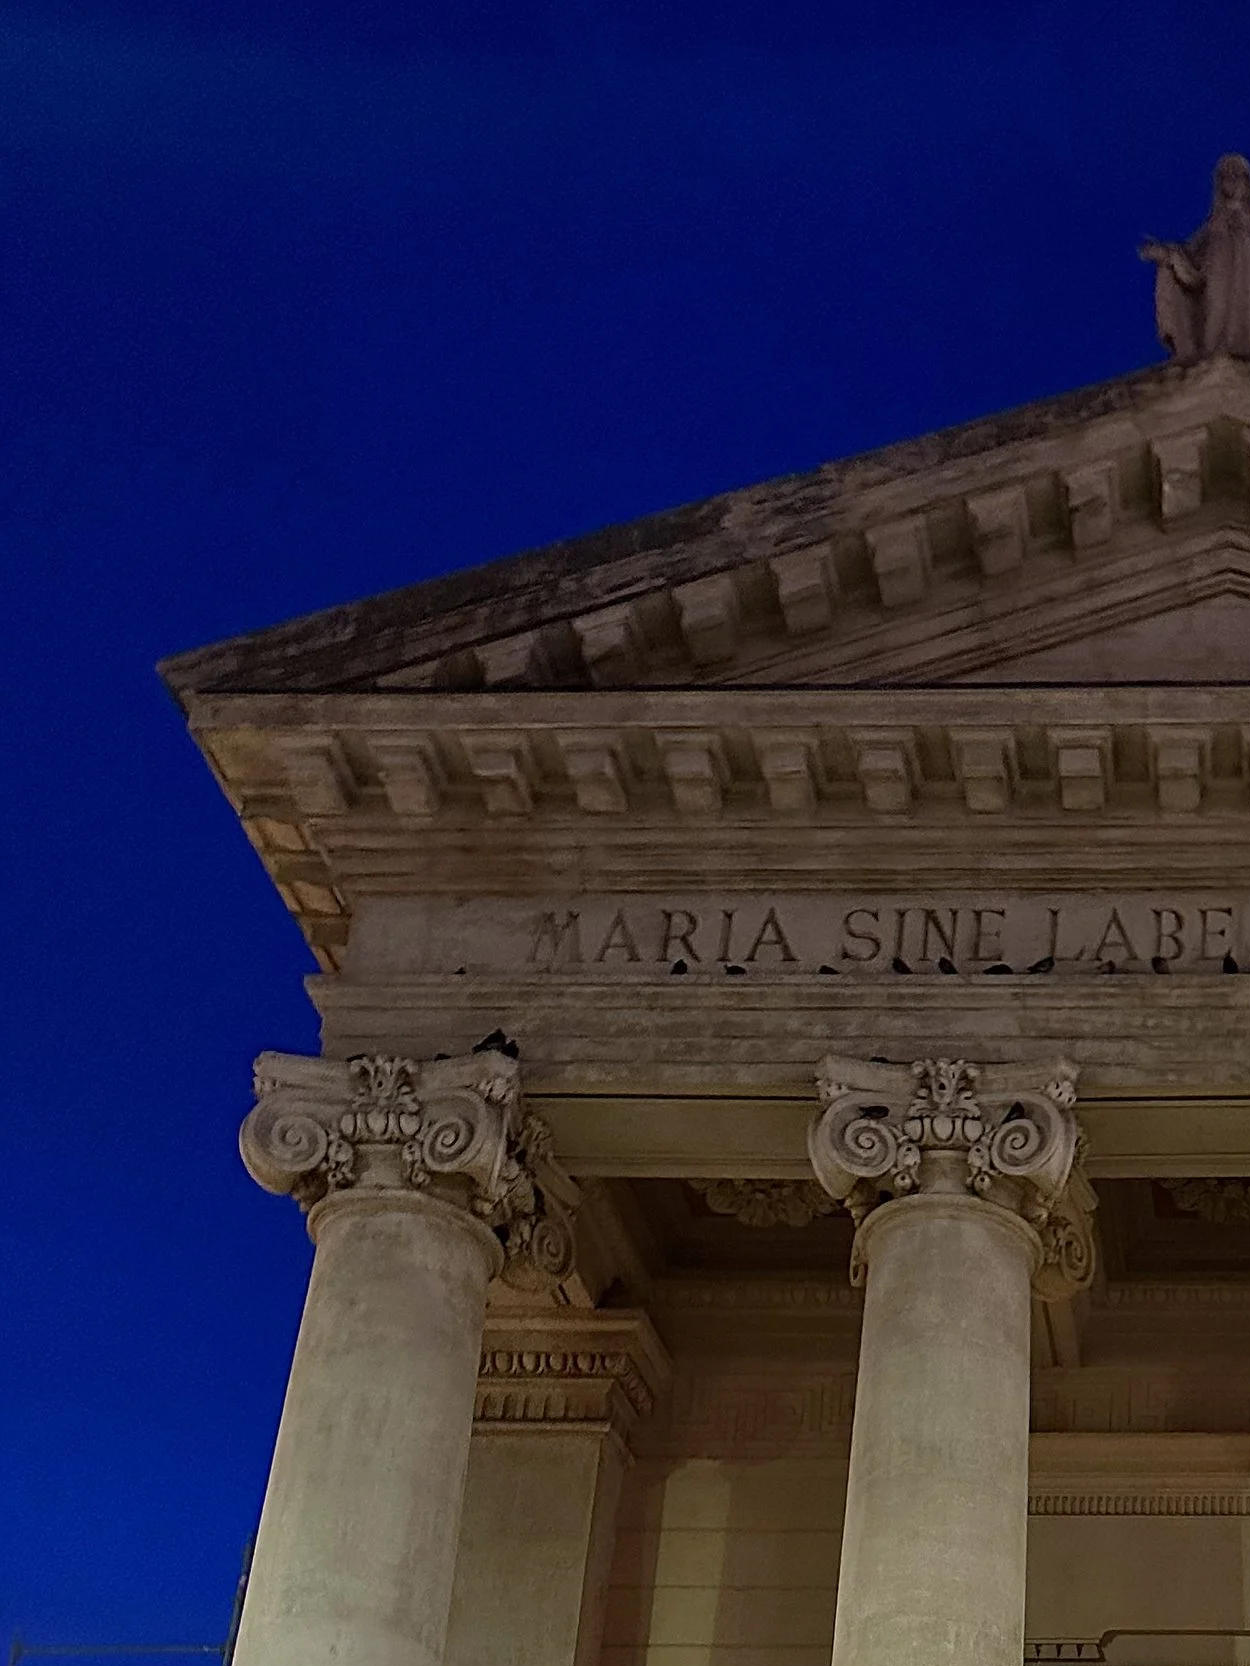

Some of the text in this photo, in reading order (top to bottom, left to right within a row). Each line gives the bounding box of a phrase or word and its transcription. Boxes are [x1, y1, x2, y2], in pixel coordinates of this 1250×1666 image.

[527, 907, 801, 963] MARIA
[841, 907, 1005, 962] SINE
[1047, 905, 1234, 961] LABE
